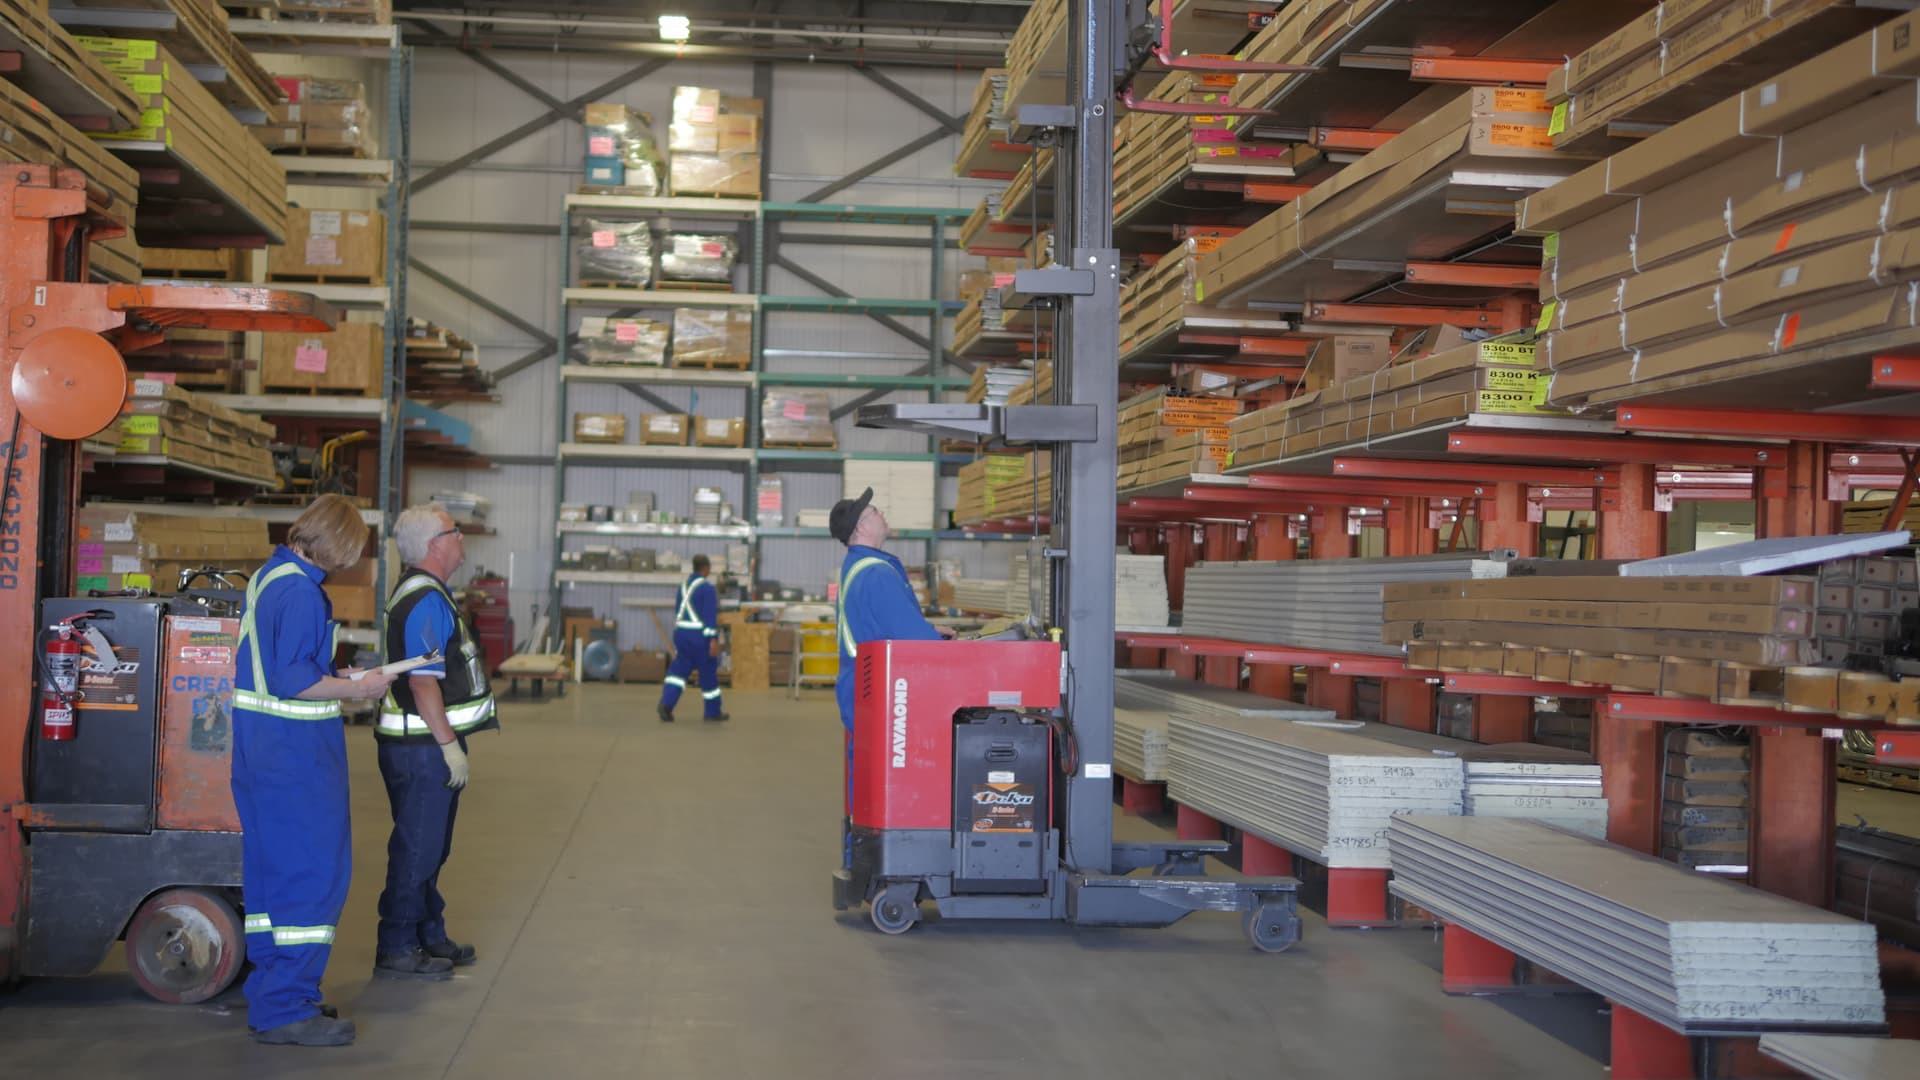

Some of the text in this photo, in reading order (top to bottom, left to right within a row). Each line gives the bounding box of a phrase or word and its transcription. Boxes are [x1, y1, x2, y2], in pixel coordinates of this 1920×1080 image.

[1482, 344, 1536, 354] 8300 BT
[1489, 370, 1523, 379] 8300
[1481, 393, 1523, 401] 8300
[0, 468, 23, 590] RAYMOND
[172, 674, 235, 692] CREA
[892, 678, 908, 768] RAYMOND
[973, 790, 1034, 805] Deka
